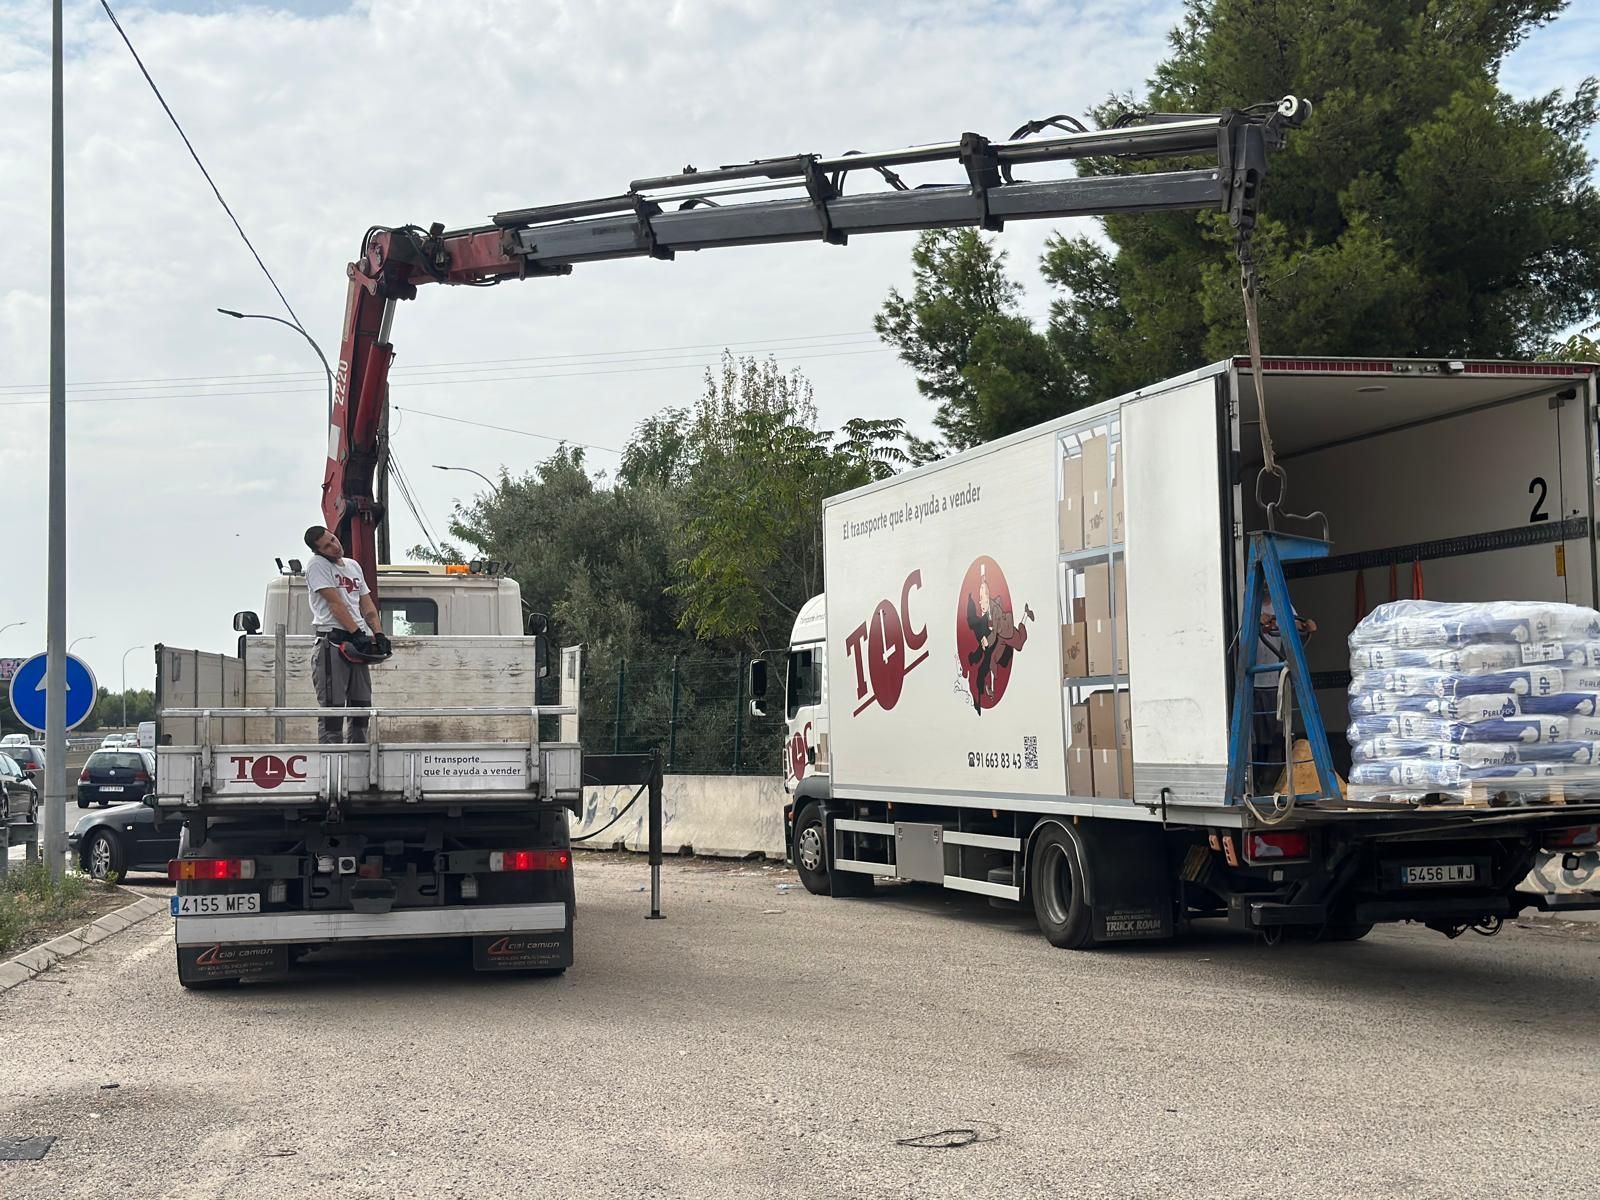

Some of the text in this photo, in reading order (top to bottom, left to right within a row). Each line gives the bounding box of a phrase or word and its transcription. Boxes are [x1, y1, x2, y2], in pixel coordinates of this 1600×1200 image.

[334, 359, 348, 406] 2220
[1528, 476, 1549, 523] 2
[842, 482, 981, 541] El transporte que le ayuda a vender
[845, 568, 929, 712] TOC
[1539, 675, 1551, 696] HP
[1548, 725, 1560, 744] HP
[424, 755, 480, 765] El transporte
[975, 751, 1022, 769] 91 663 83 43
[230, 754, 308, 790] TOC
[423, 767, 441, 776] que
[443, 767, 451, 775] le
[453, 767, 480, 776] ayuda
[490, 766, 521, 775] vender
[1409, 865, 1473, 882] 5456 LWJ
[181, 896, 256, 913] 4155 MFS
